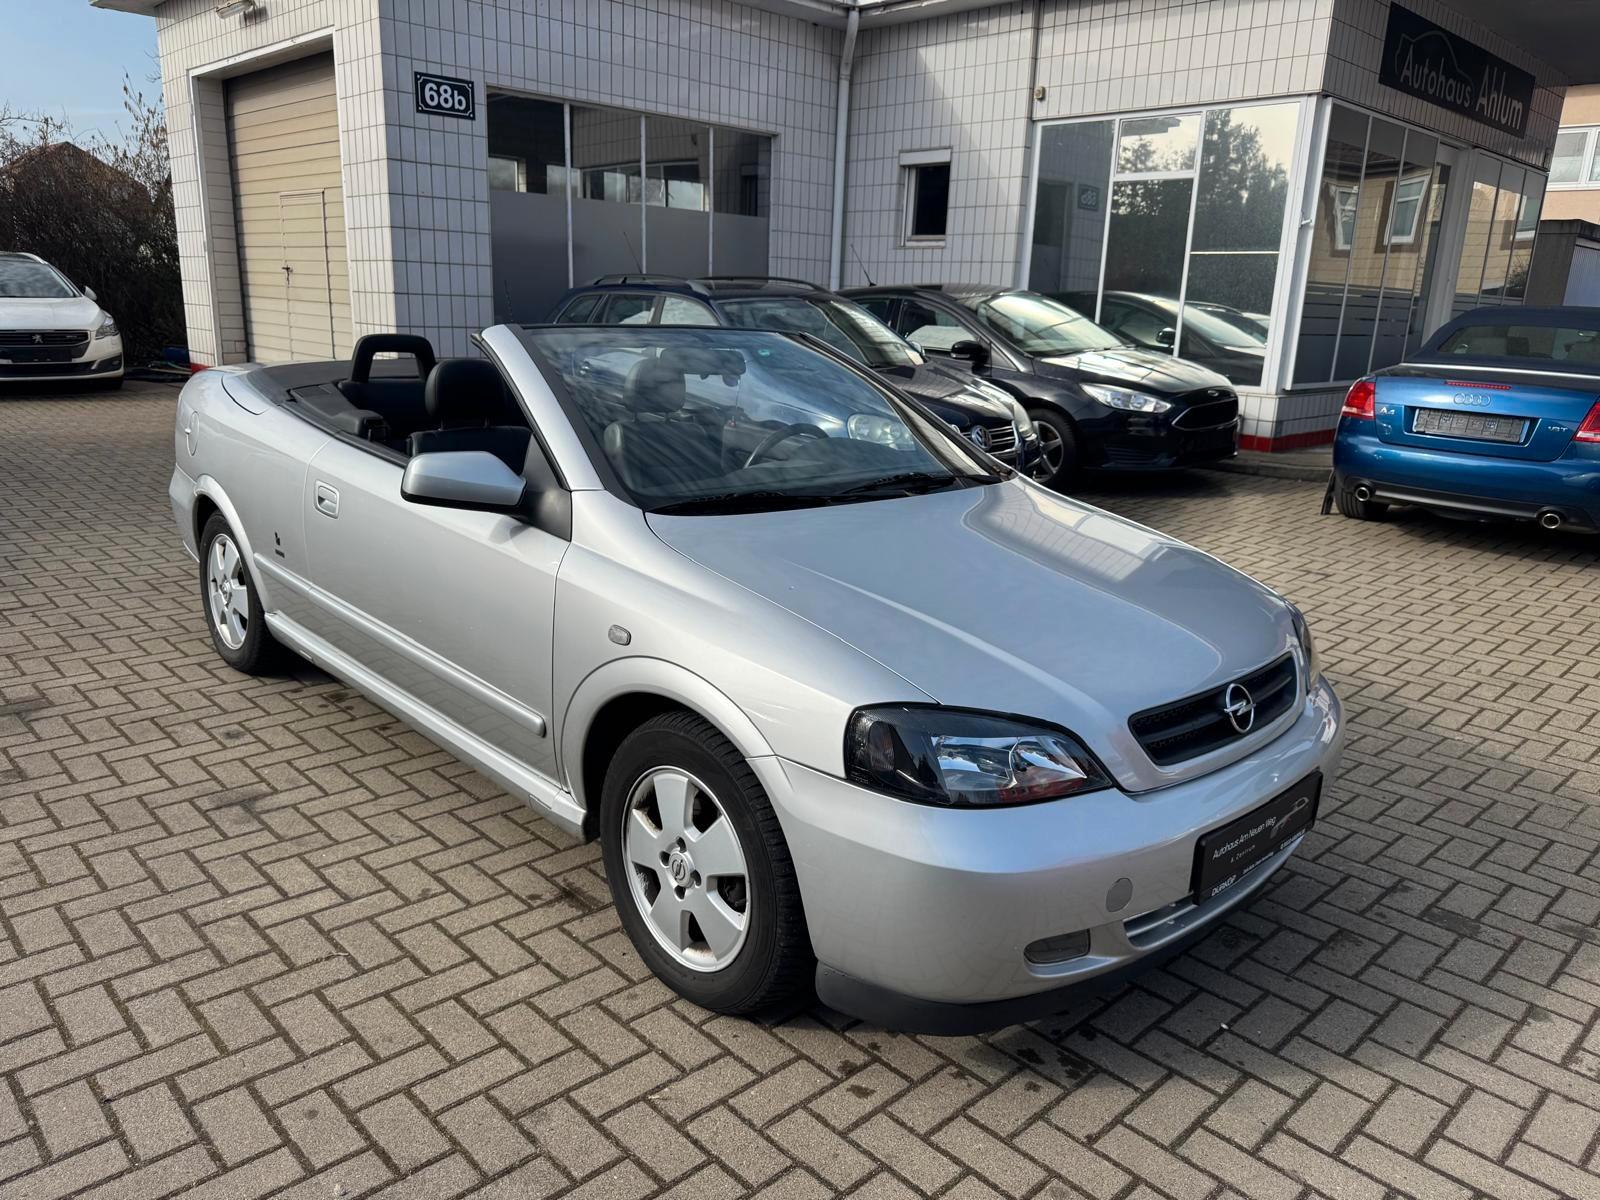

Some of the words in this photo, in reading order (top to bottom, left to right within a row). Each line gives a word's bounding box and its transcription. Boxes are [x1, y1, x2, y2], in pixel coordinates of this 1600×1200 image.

[425, 83, 466, 110] 68b
[1400, 43, 1472, 108] Autohaus
[1476, 64, 1523, 130] Ahlum
